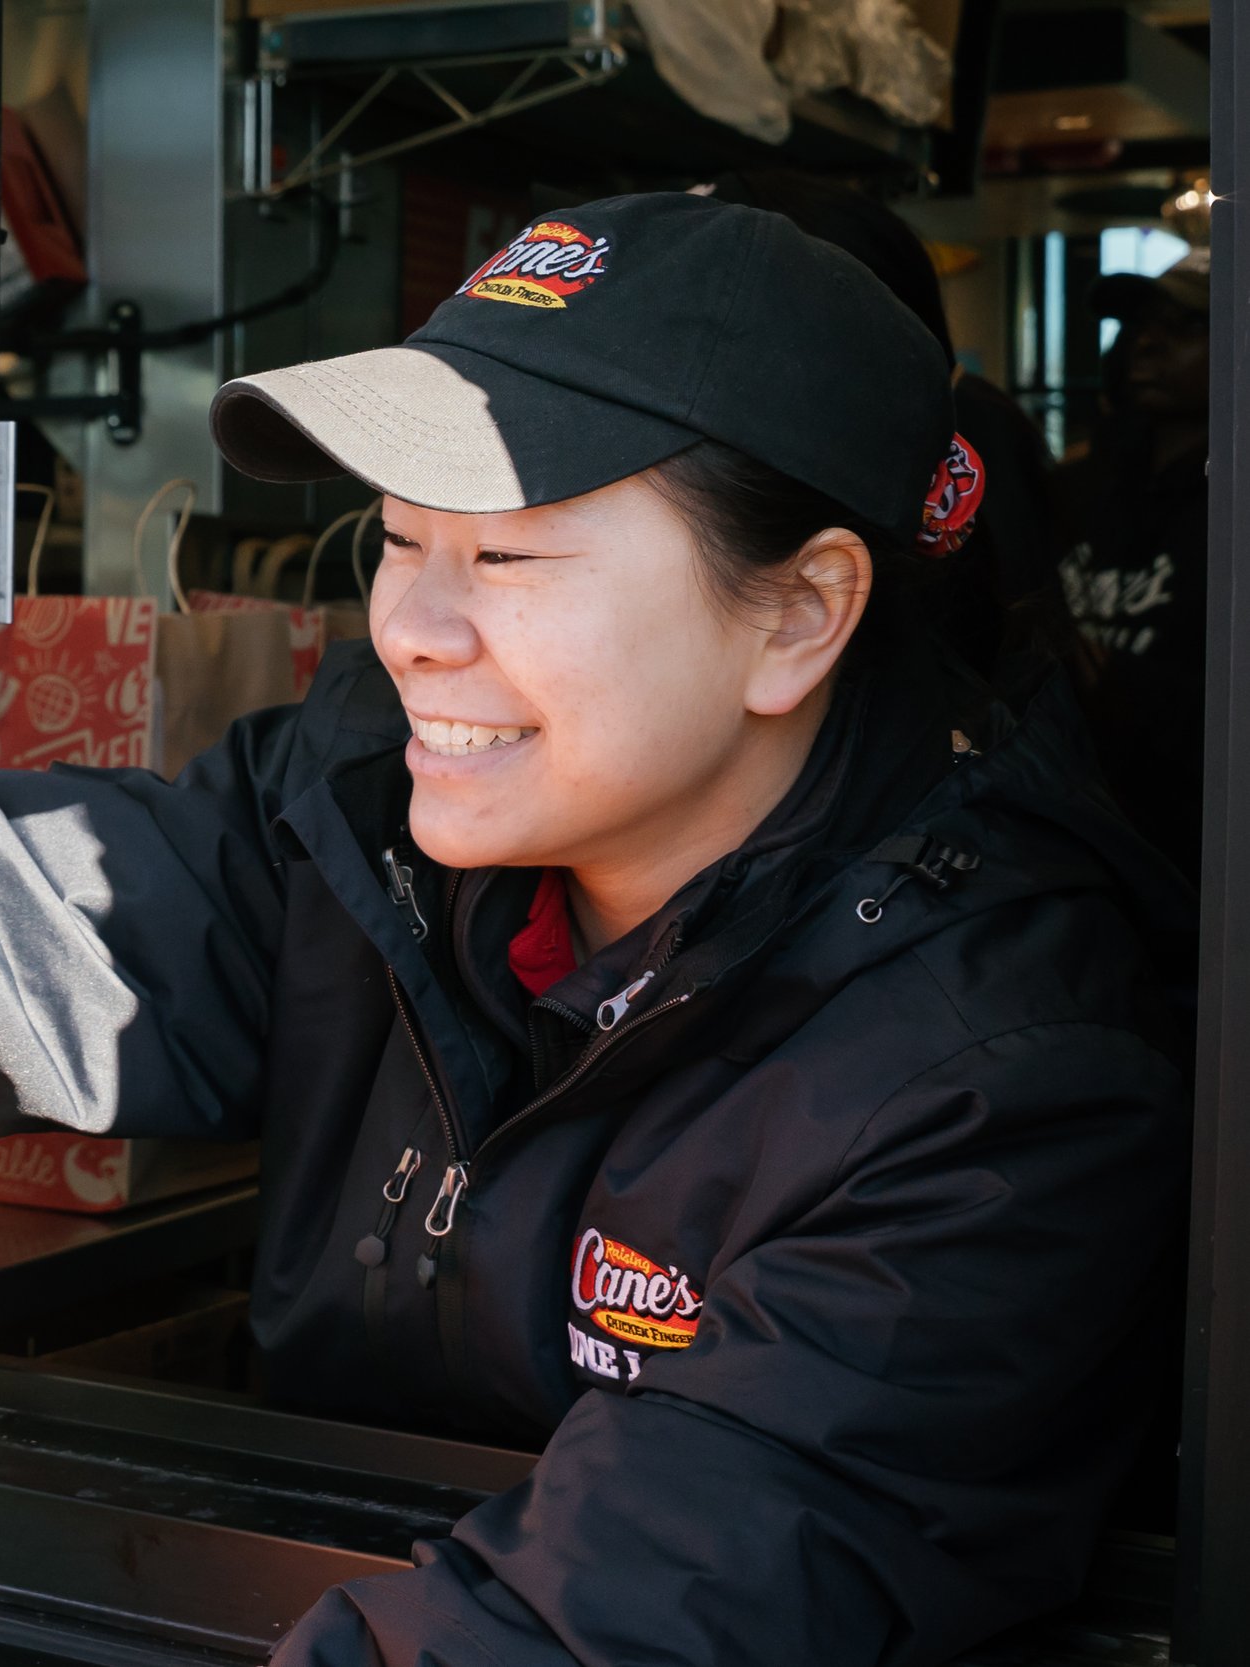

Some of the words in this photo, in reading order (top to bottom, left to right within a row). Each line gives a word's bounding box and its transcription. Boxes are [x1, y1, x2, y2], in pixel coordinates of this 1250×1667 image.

[572, 1228, 703, 1316] Cane's
[605, 1240, 650, 1274] Raising
[606, 1314, 649, 1339] CHICKEN
[650, 1327, 695, 1344] FINGER
